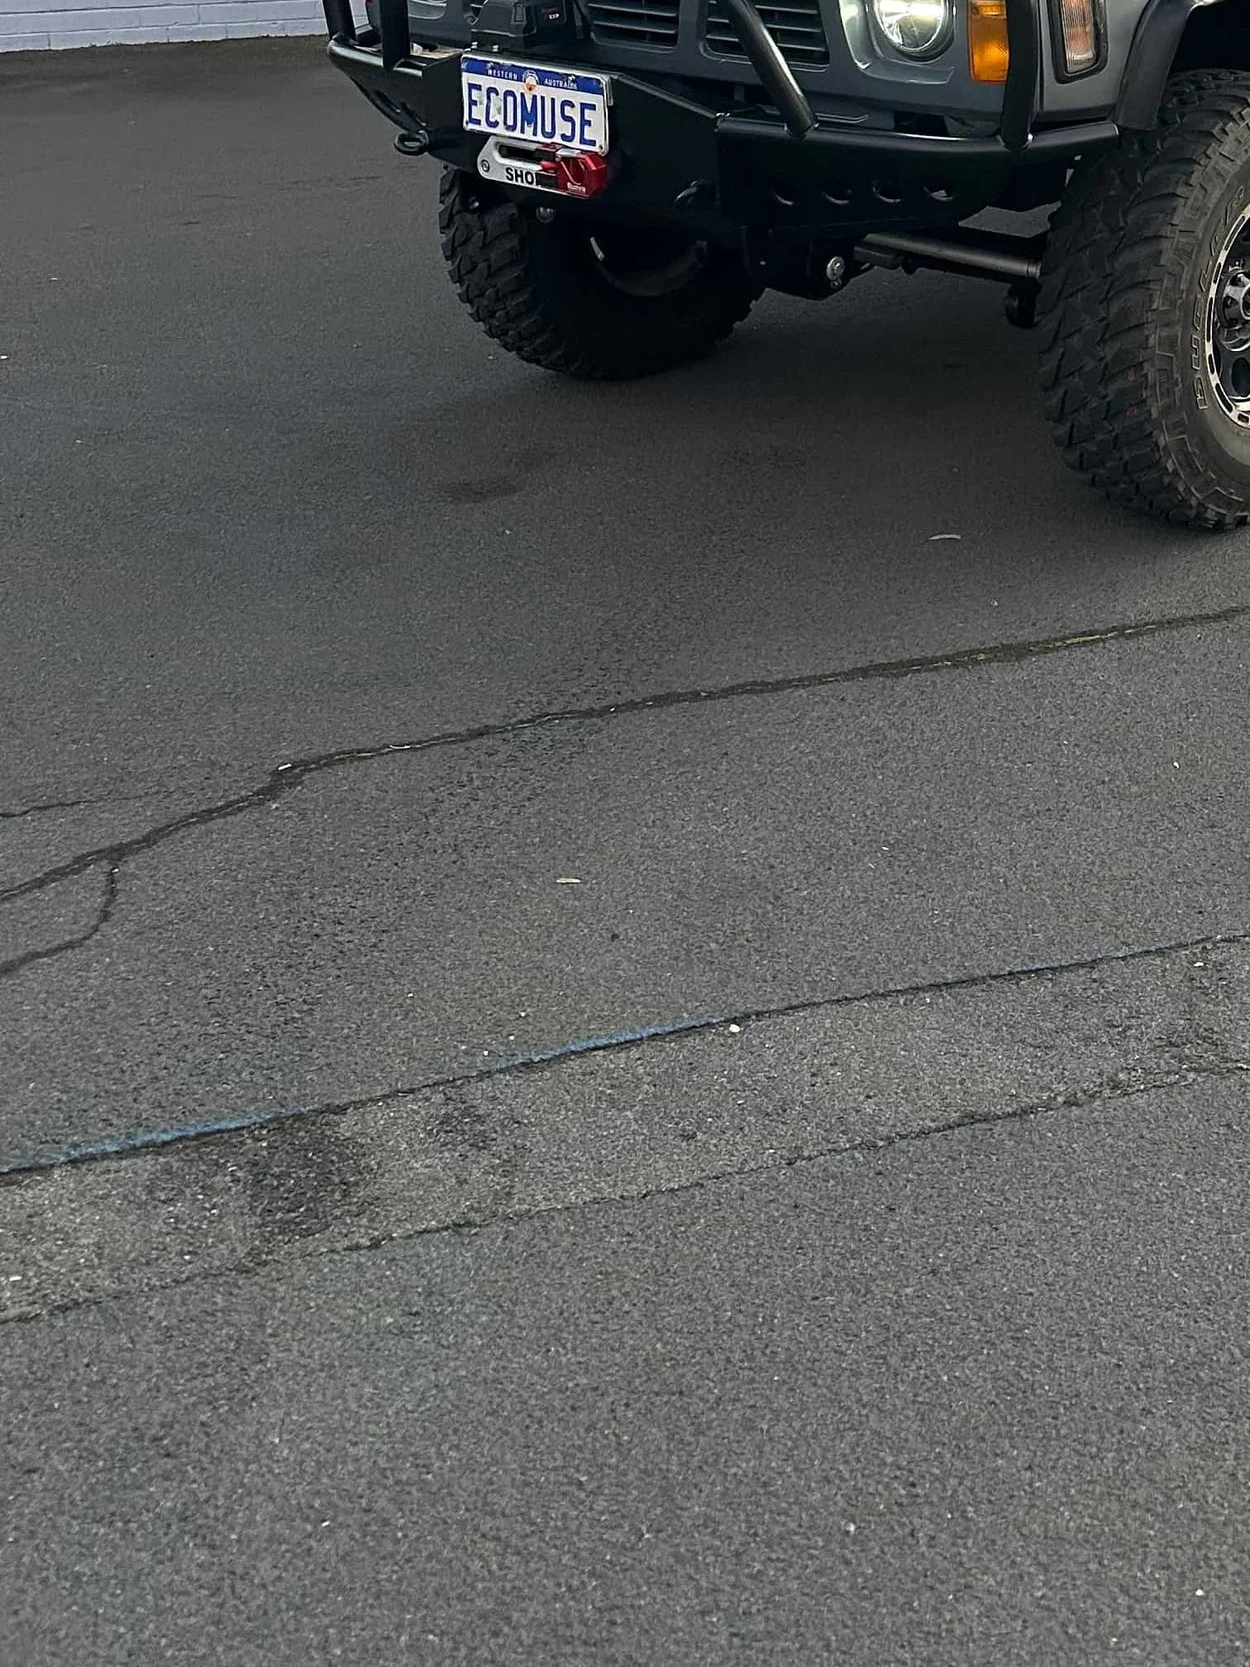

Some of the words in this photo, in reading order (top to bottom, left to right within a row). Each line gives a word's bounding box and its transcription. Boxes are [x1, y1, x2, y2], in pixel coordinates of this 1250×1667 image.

[487, 69, 518, 81] WESTERN
[467, 82, 597, 146] ECOMUSE
[505, 167, 537, 185] SHO
